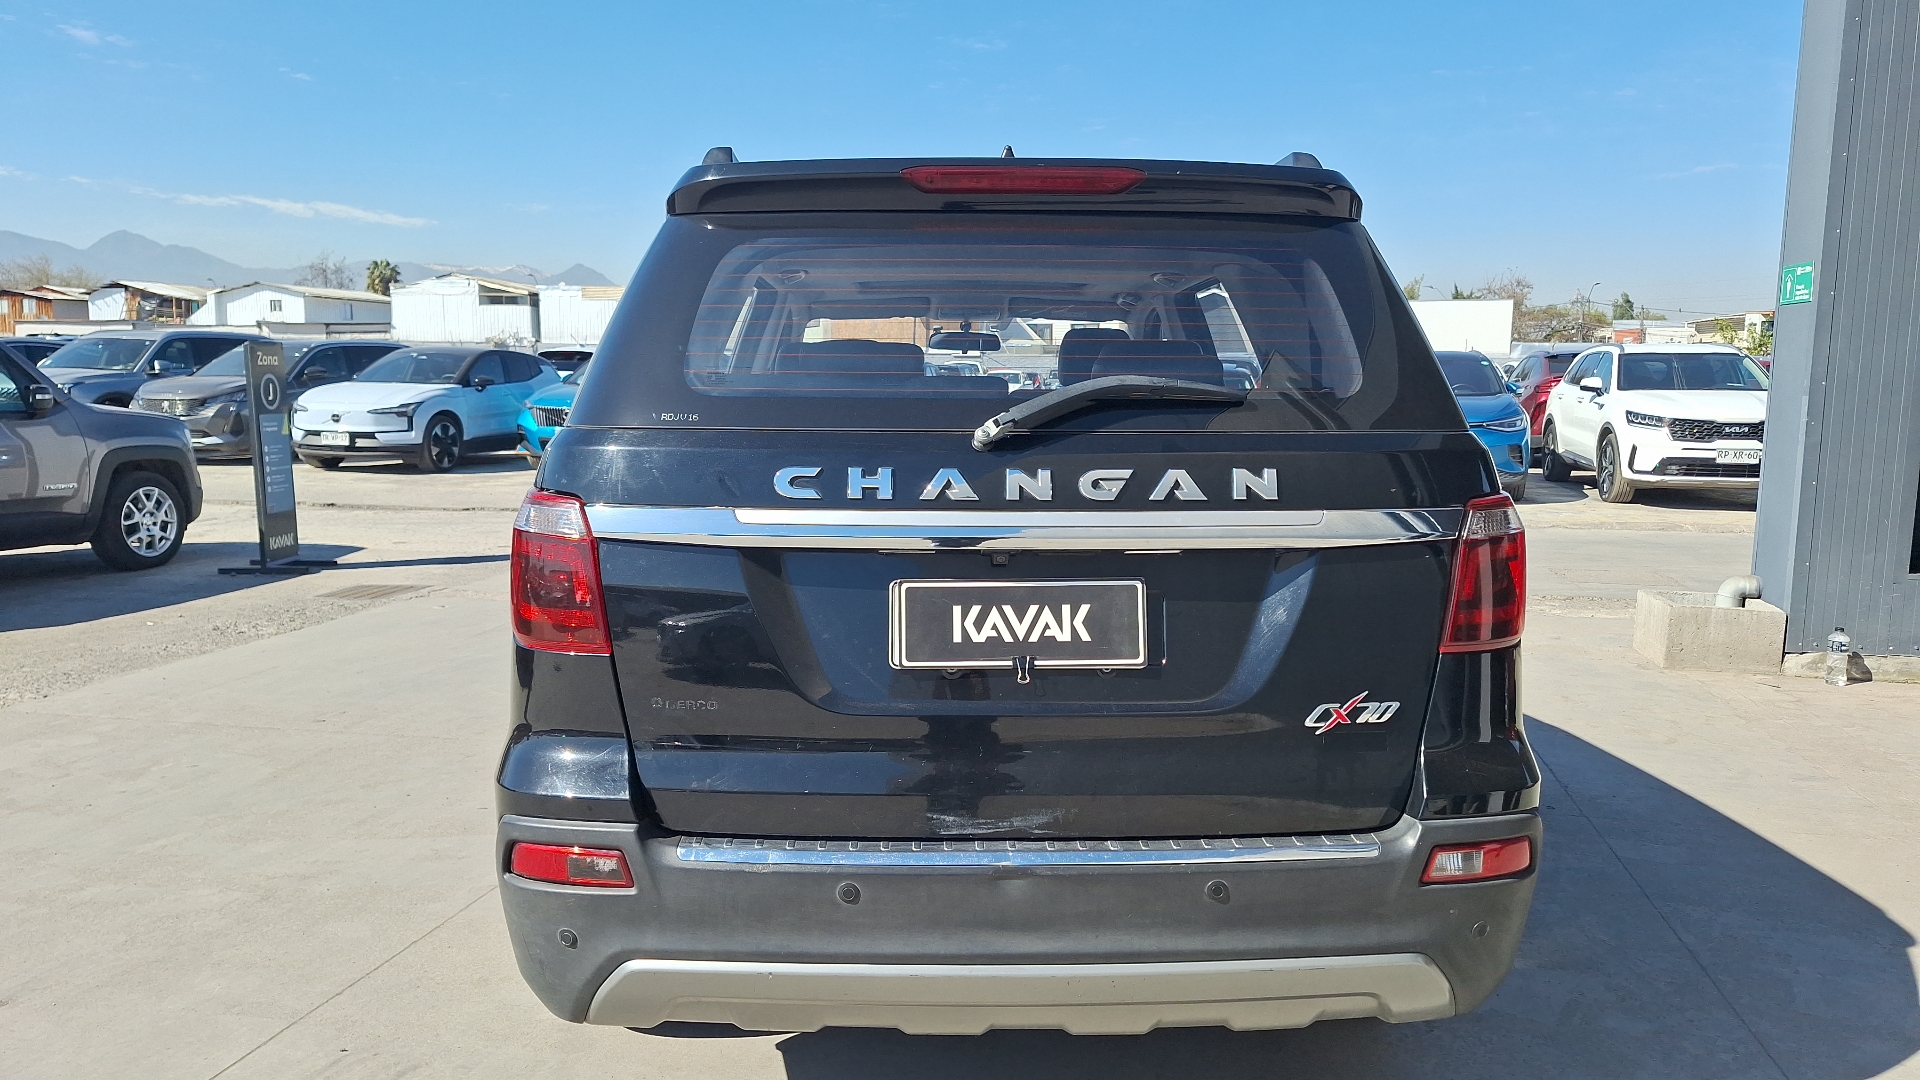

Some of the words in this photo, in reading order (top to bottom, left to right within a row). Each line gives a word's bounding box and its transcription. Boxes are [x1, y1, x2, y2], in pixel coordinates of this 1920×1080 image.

[257, 351, 279, 366] Zona
[773, 466, 1279, 501] CHANGAN
[269, 532, 294, 550] KAVAK
[952, 603, 1092, 643] KAVAK
[1304, 690, 1400, 735] CX70
